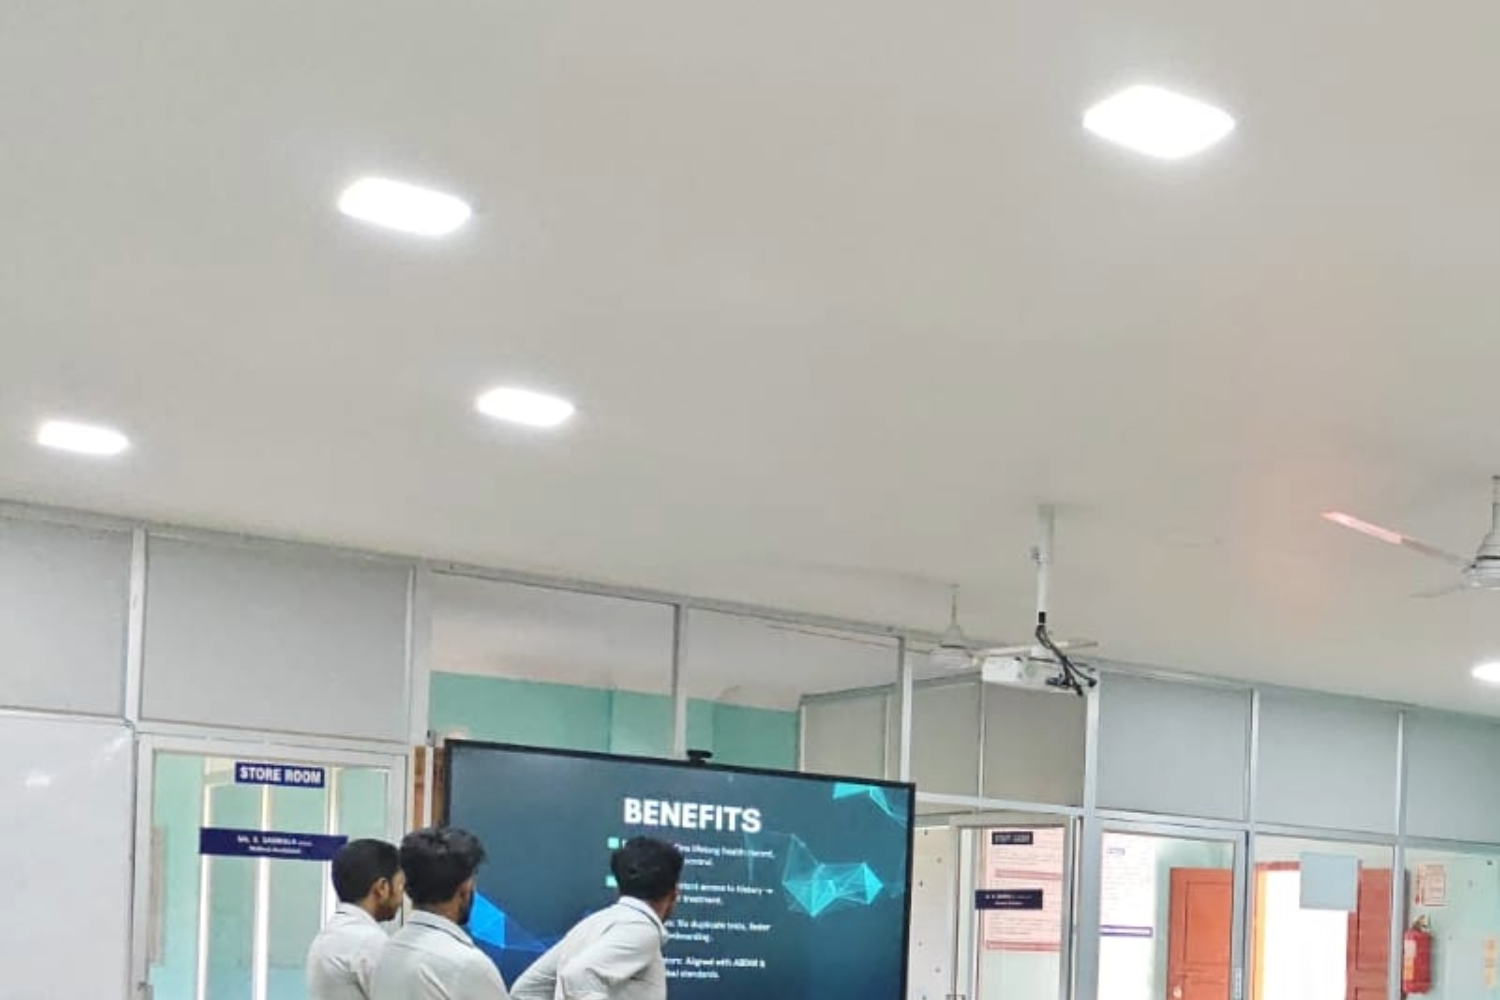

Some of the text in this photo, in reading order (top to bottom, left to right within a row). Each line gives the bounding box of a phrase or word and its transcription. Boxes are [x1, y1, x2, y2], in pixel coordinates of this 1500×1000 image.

[240, 765, 322, 784] STORE ROOM
[623, 797, 762, 833] BENEFITS
